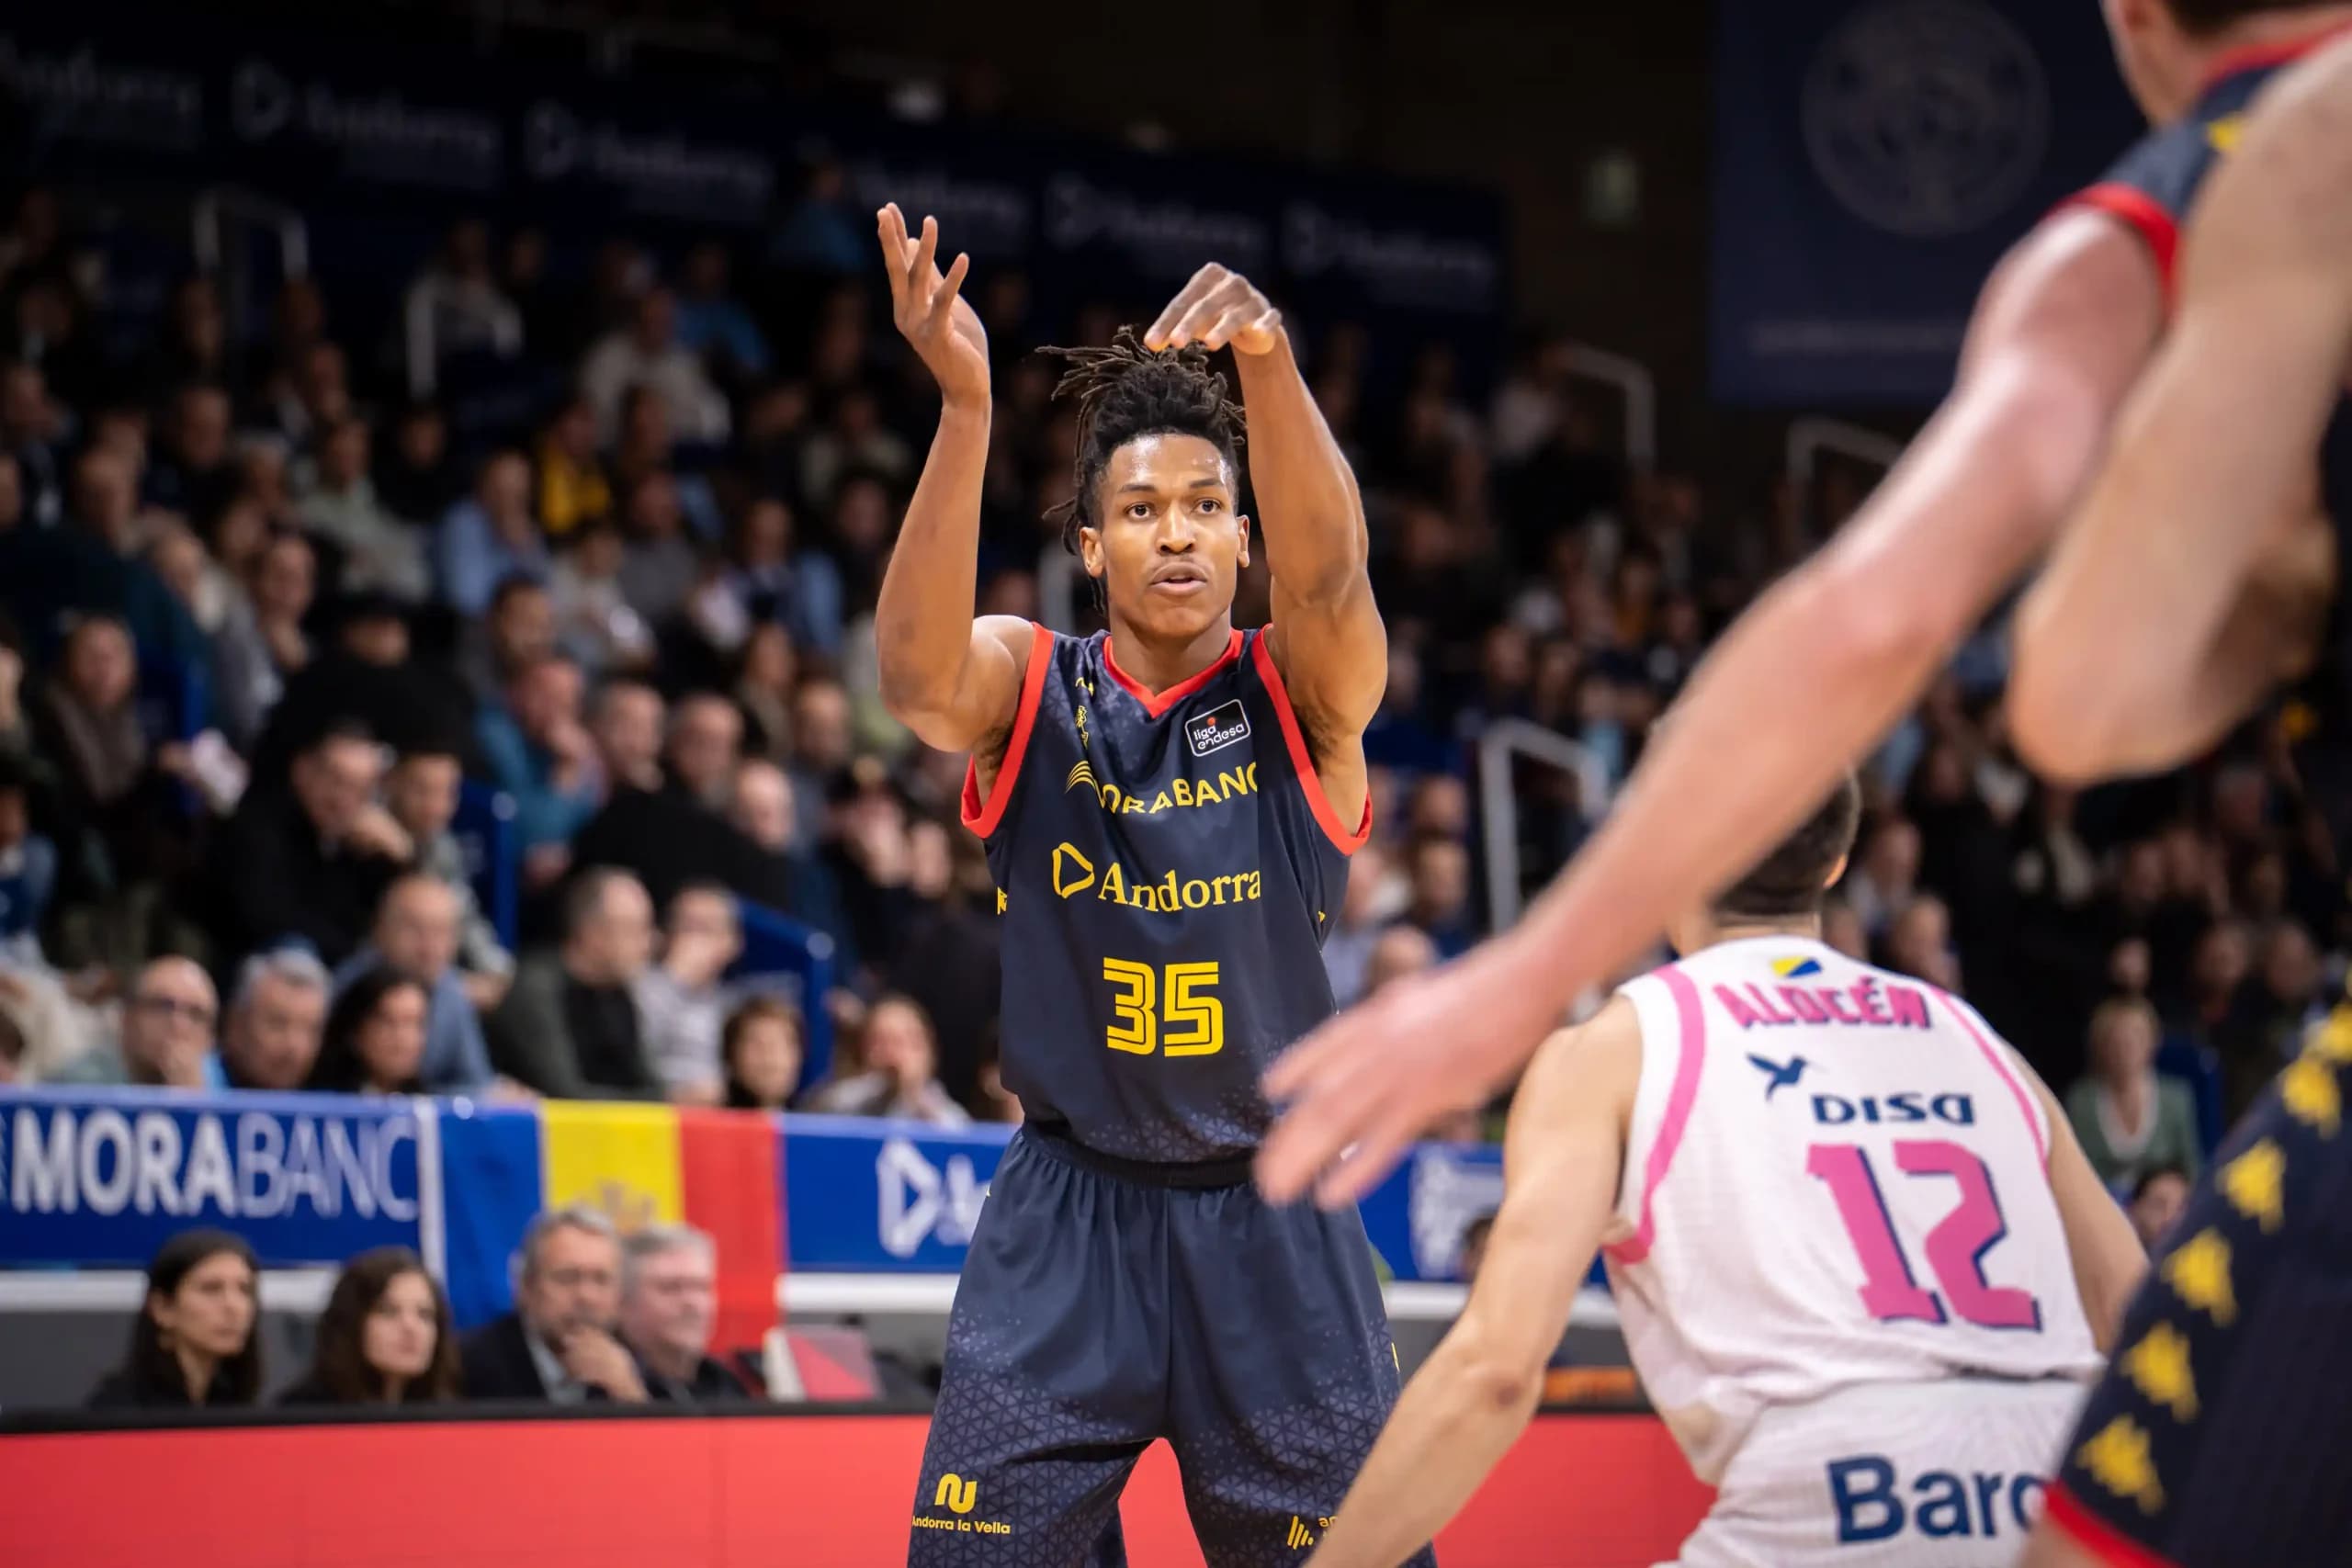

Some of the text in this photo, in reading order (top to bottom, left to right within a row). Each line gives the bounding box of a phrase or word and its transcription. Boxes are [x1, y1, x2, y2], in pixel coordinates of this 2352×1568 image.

[1193, 725, 1217, 741] liga
[1197, 722, 1246, 750] endesa
[1098, 862, 1260, 913] Andorra
[1102, 956, 1225, 1058] 35
[11, 1106, 419, 1221] MORABANC
[1806, 1139, 2042, 1333] 12
[958, 1520, 971, 1531] la
[975, 1521, 1011, 1534] Vella
